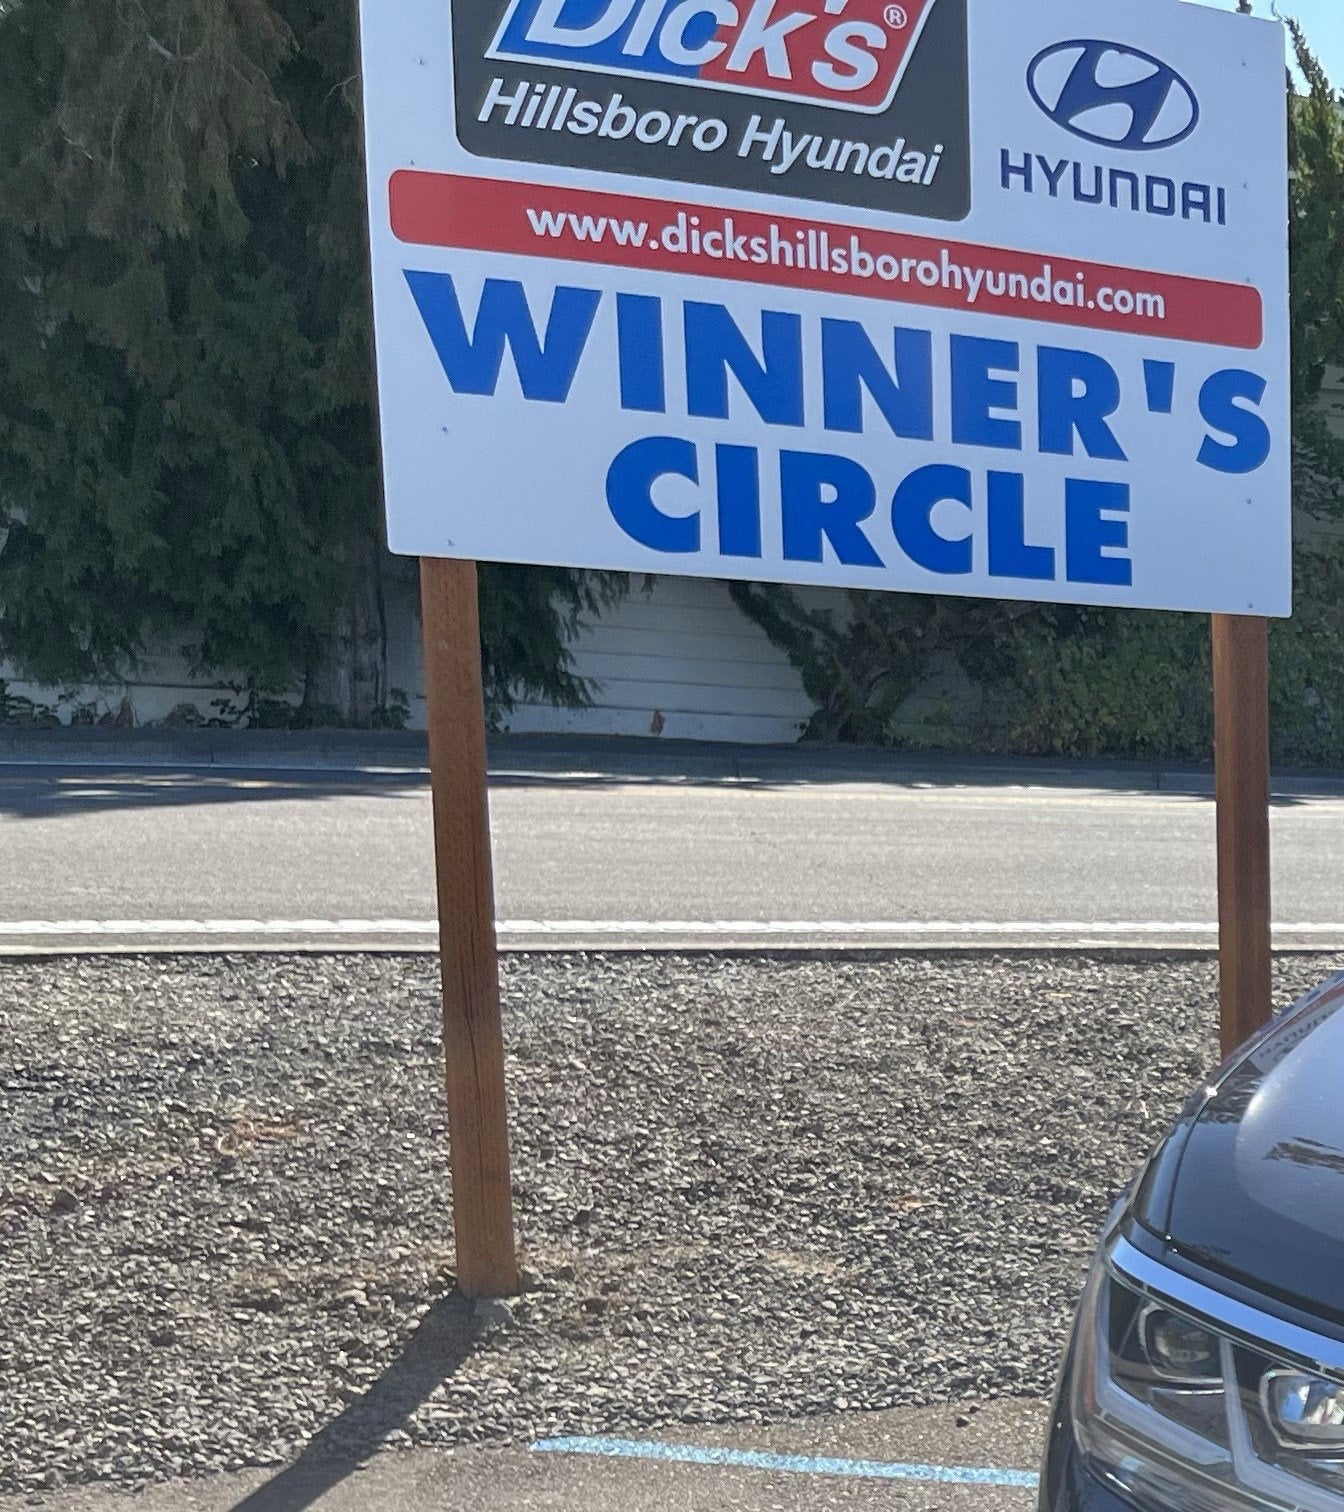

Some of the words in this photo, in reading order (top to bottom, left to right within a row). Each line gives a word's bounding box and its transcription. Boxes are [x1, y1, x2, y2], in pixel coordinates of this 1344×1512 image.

[477, 78, 729, 152] Hillsboro
[737, 115, 945, 186] Hyundai
[1000, 147, 1227, 226] HYUNDAI
[525, 208, 1166, 320] www.dickshillsborohyundai.com
[402, 269, 1271, 474] WINNER'S
[605, 436, 1133, 587] CIRCLE
